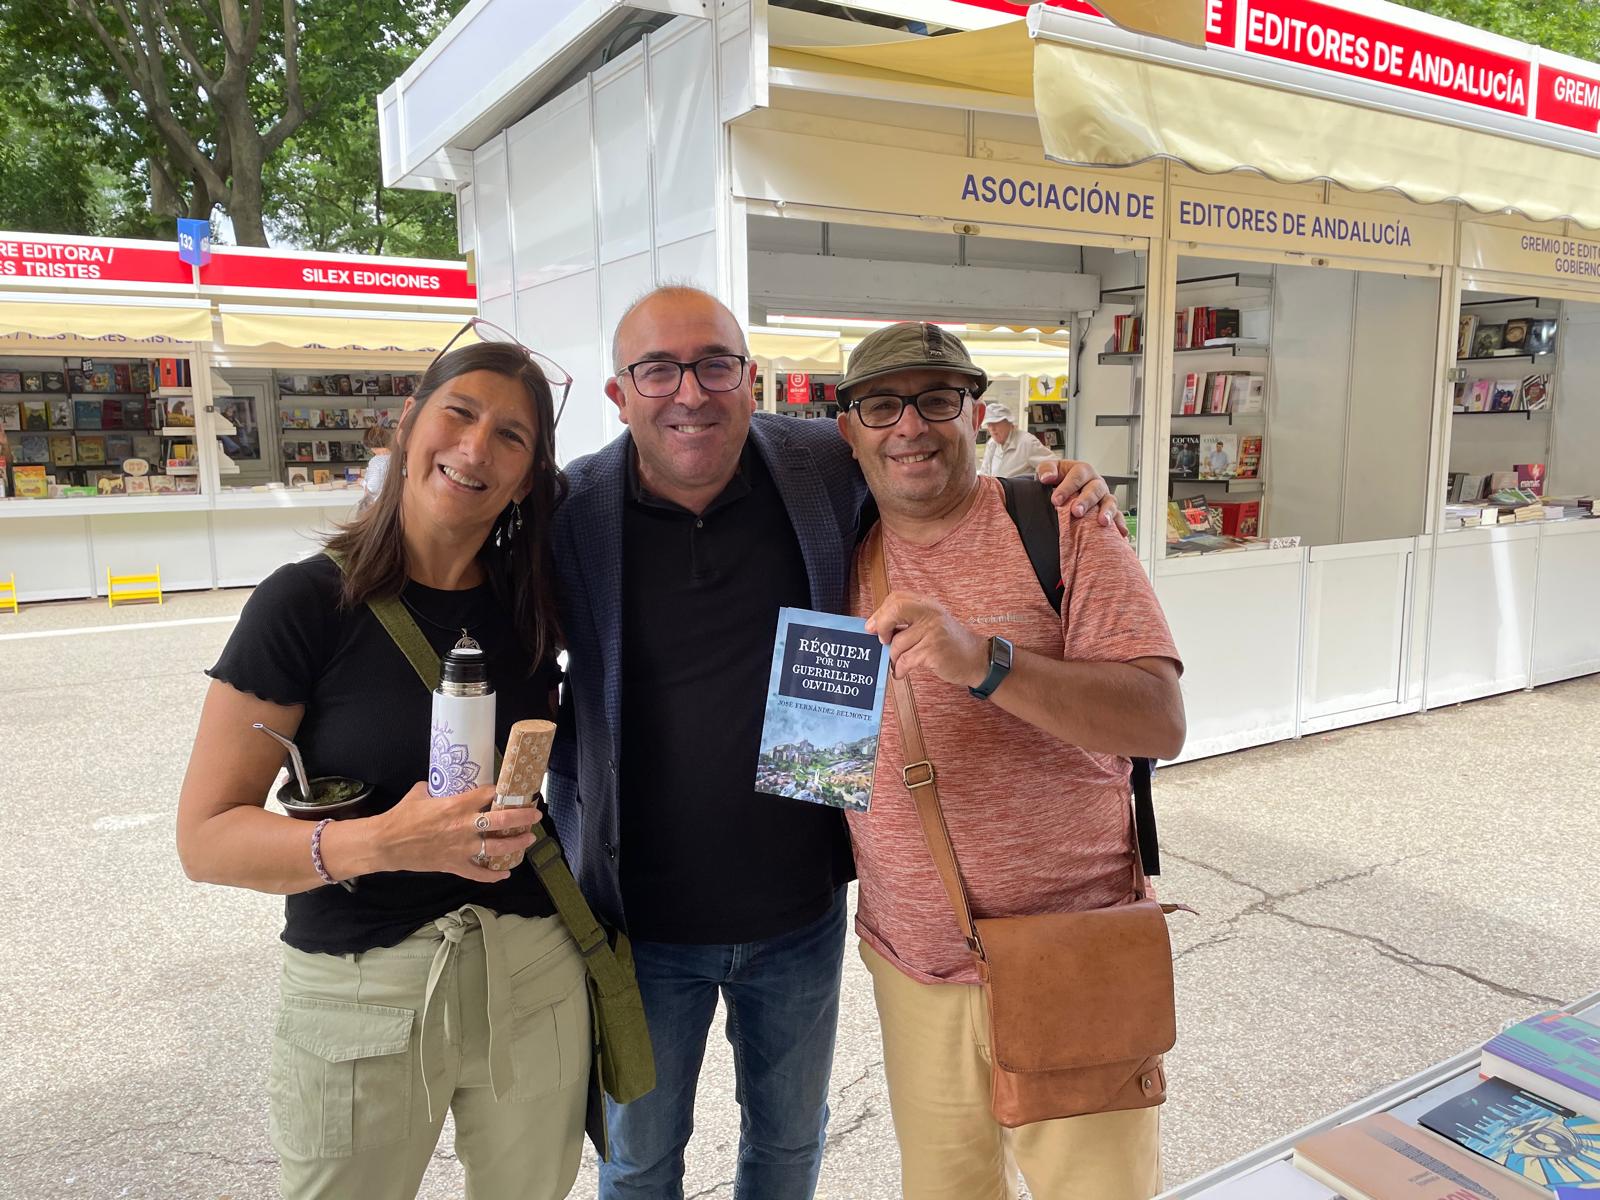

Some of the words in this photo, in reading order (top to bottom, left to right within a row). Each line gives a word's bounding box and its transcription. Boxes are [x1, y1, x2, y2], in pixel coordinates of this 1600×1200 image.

[1248, 8, 1370, 69] EDITORES
[1374, 40, 1404, 77] DE
[1408, 50, 1525, 106] ANDALUCÍA
[961, 174, 1120, 216] ASOCIACIÓN
[1127, 192, 1155, 219] DE
[1180, 200, 1278, 233] EDITORES
[1283, 213, 1306, 236] DE
[1311, 216, 1411, 247] ANDALUCÍA
[22, 243, 105, 262] EDITORA
[180, 232, 193, 251] 132
[1521, 235, 1561, 254] GREMIO
[1562, 241, 1576, 256] DE
[1577, 243, 1600, 260] EDIT
[0, 260, 17, 275] S
[22, 261, 101, 278] TRISTES
[302, 267, 350, 284] SILEX
[353, 271, 440, 289] EDICIONES
[799, 637, 871, 660] RÉQUIEM
[816, 655, 834, 667] POR
[836, 659, 851, 669] UN
[792, 664, 874, 686] GUERRILLERO
[802, 678, 860, 697] OLVIDADO
